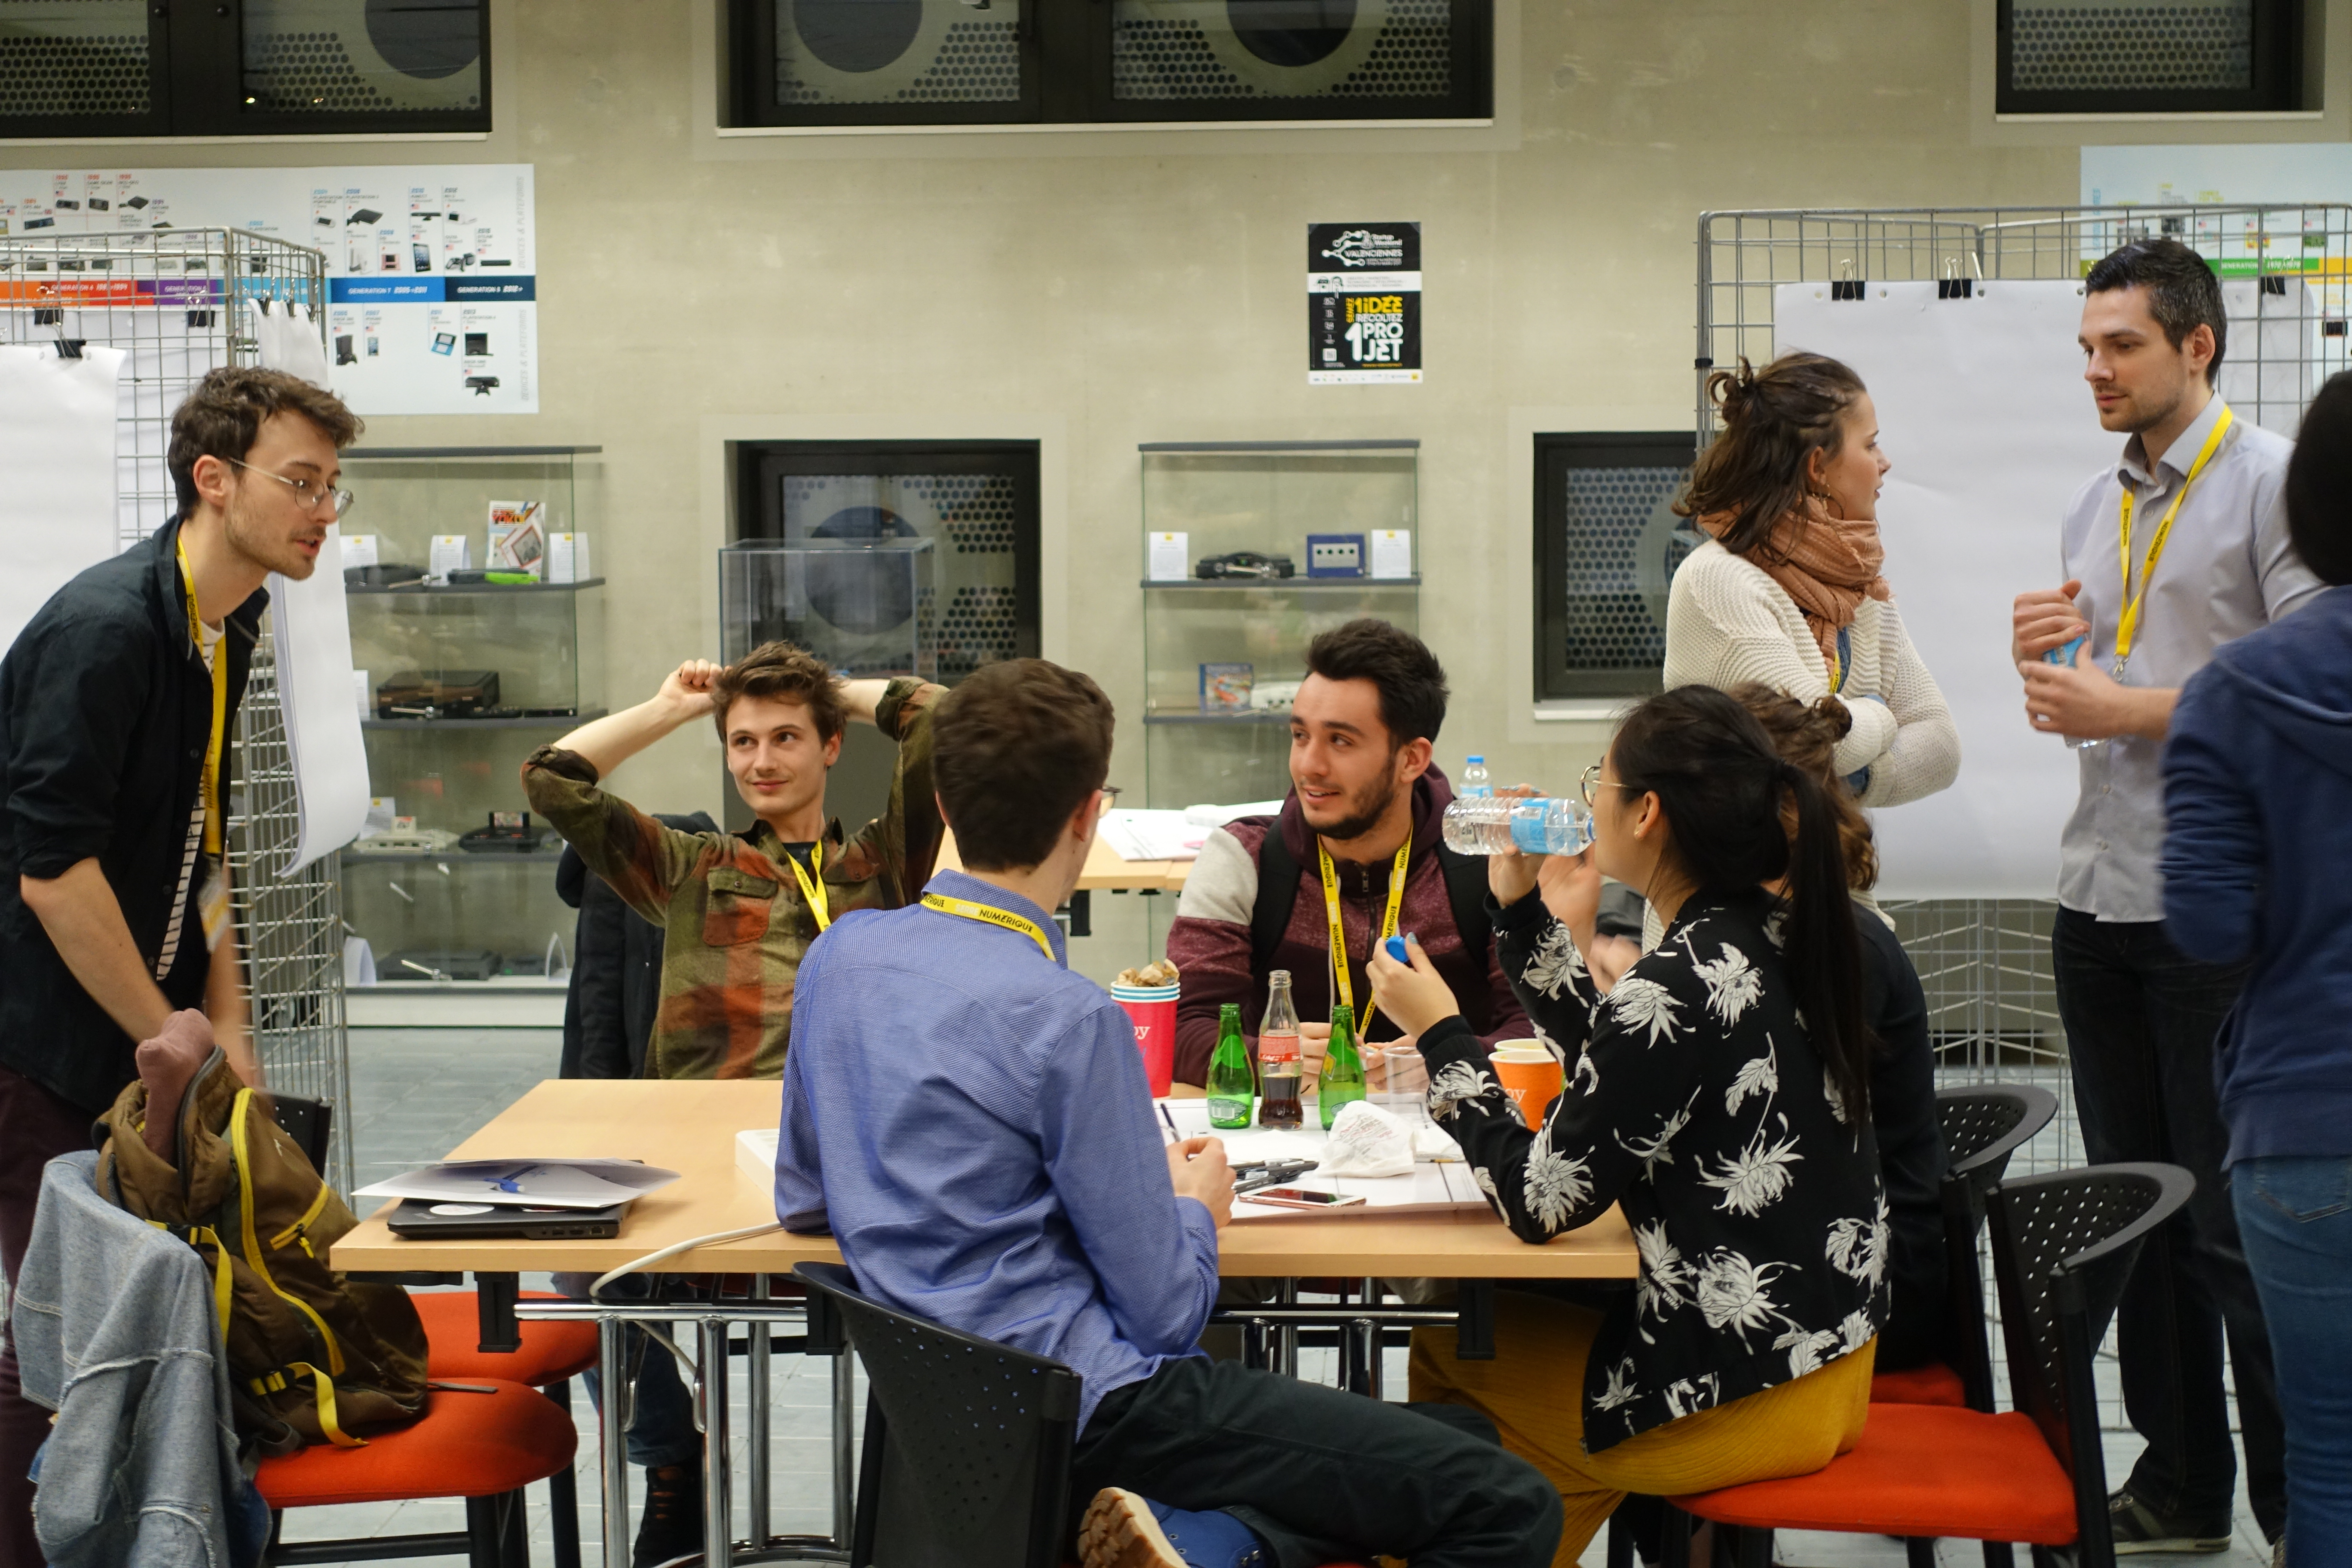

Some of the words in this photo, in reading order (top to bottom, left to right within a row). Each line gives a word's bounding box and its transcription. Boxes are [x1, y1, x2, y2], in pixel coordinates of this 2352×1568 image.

[1344, 322, 1363, 361] 1
[1363, 322, 1404, 340] PRO
[1363, 338, 1403, 361] JET
